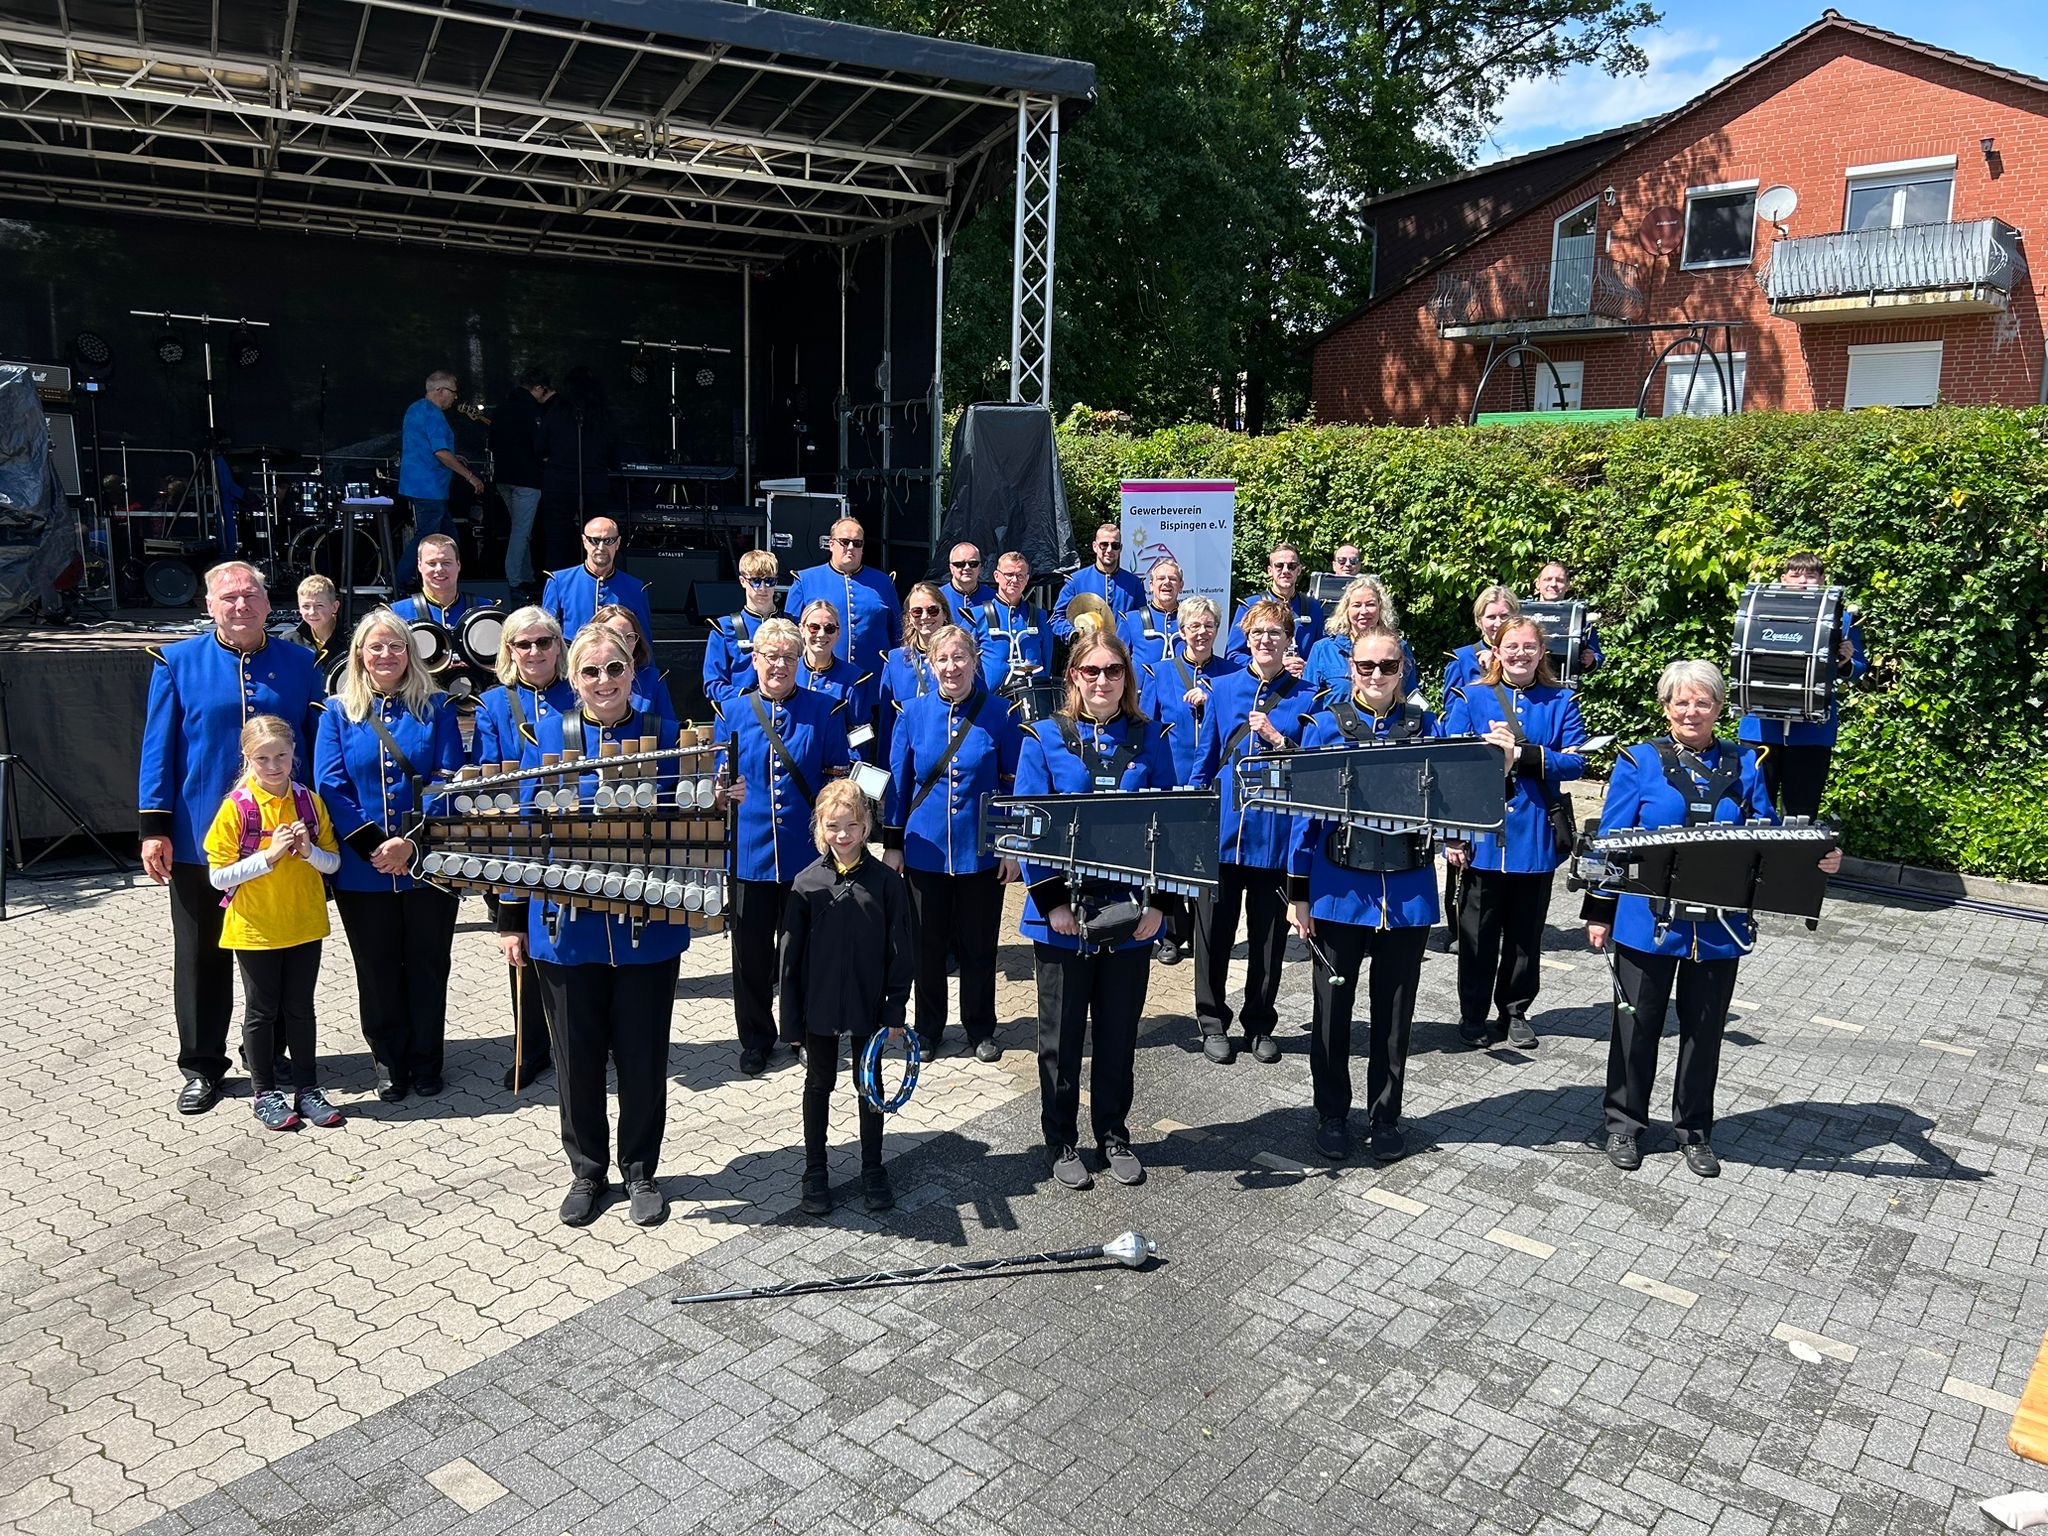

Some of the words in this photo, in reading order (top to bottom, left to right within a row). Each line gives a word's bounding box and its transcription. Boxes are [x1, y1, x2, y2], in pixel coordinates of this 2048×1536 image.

[1129, 505, 1202, 515] Gewerbeverein
[1160, 521, 1207, 531] Bispingen
[1762, 629, 1804, 643] Dynasty
[443, 761, 573, 790] SPIELMANNSZUG
[575, 745, 709, 767] SCHNEVERDINGEN
[1592, 831, 1704, 849] SPIELMANNSZUG
[1706, 830, 1825, 841] SCHNEVERDINGEN
